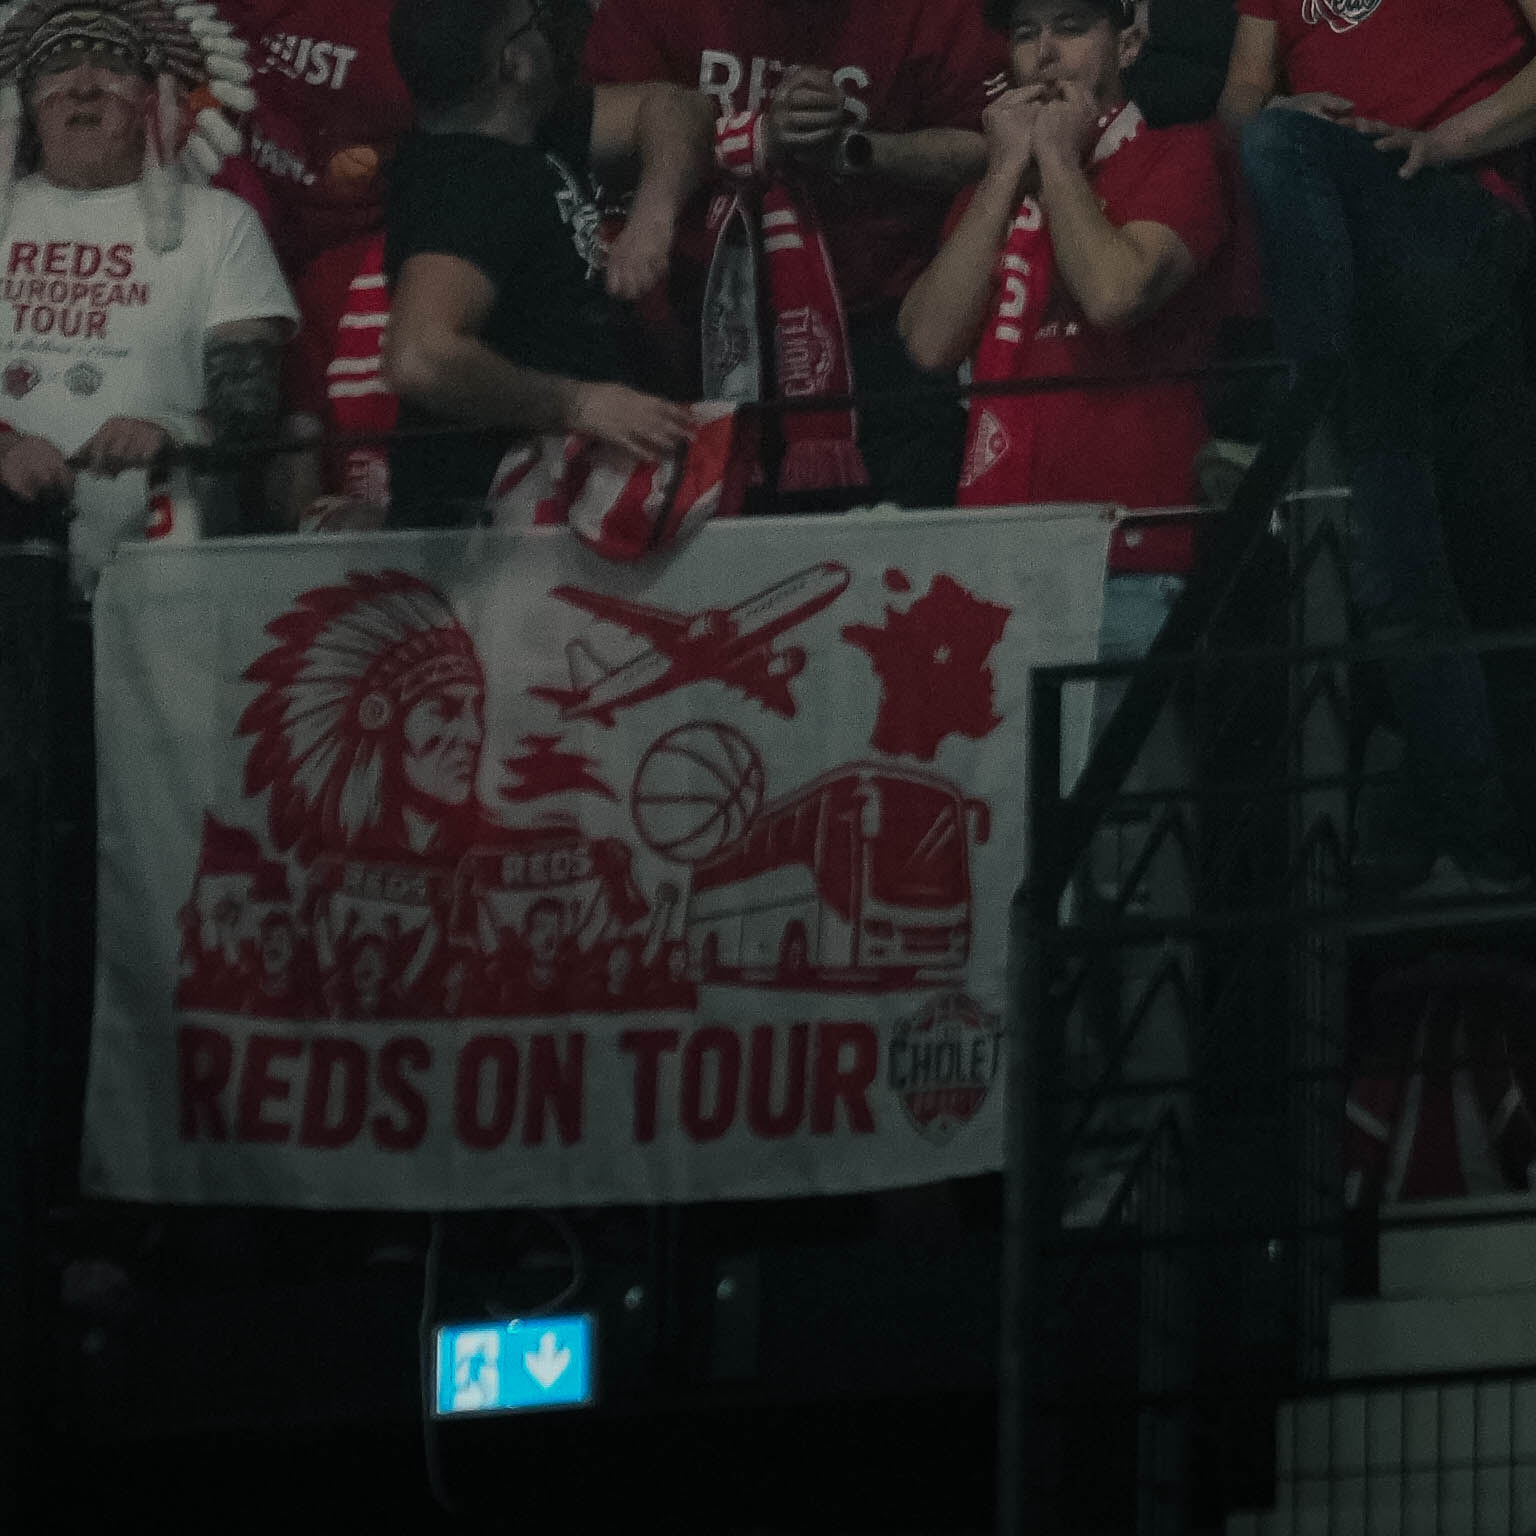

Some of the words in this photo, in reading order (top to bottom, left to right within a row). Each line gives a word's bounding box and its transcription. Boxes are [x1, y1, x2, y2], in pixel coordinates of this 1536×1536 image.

[8, 240, 134, 279] REDS
[0, 278, 150, 307] UROPEAN
[13, 303, 108, 339] TOUR
[888, 1032, 1003, 1089] CHOLET
[177, 1024, 432, 1152] REDS
[455, 1031, 585, 1150] ON
[618, 1021, 878, 1144] TOUR
